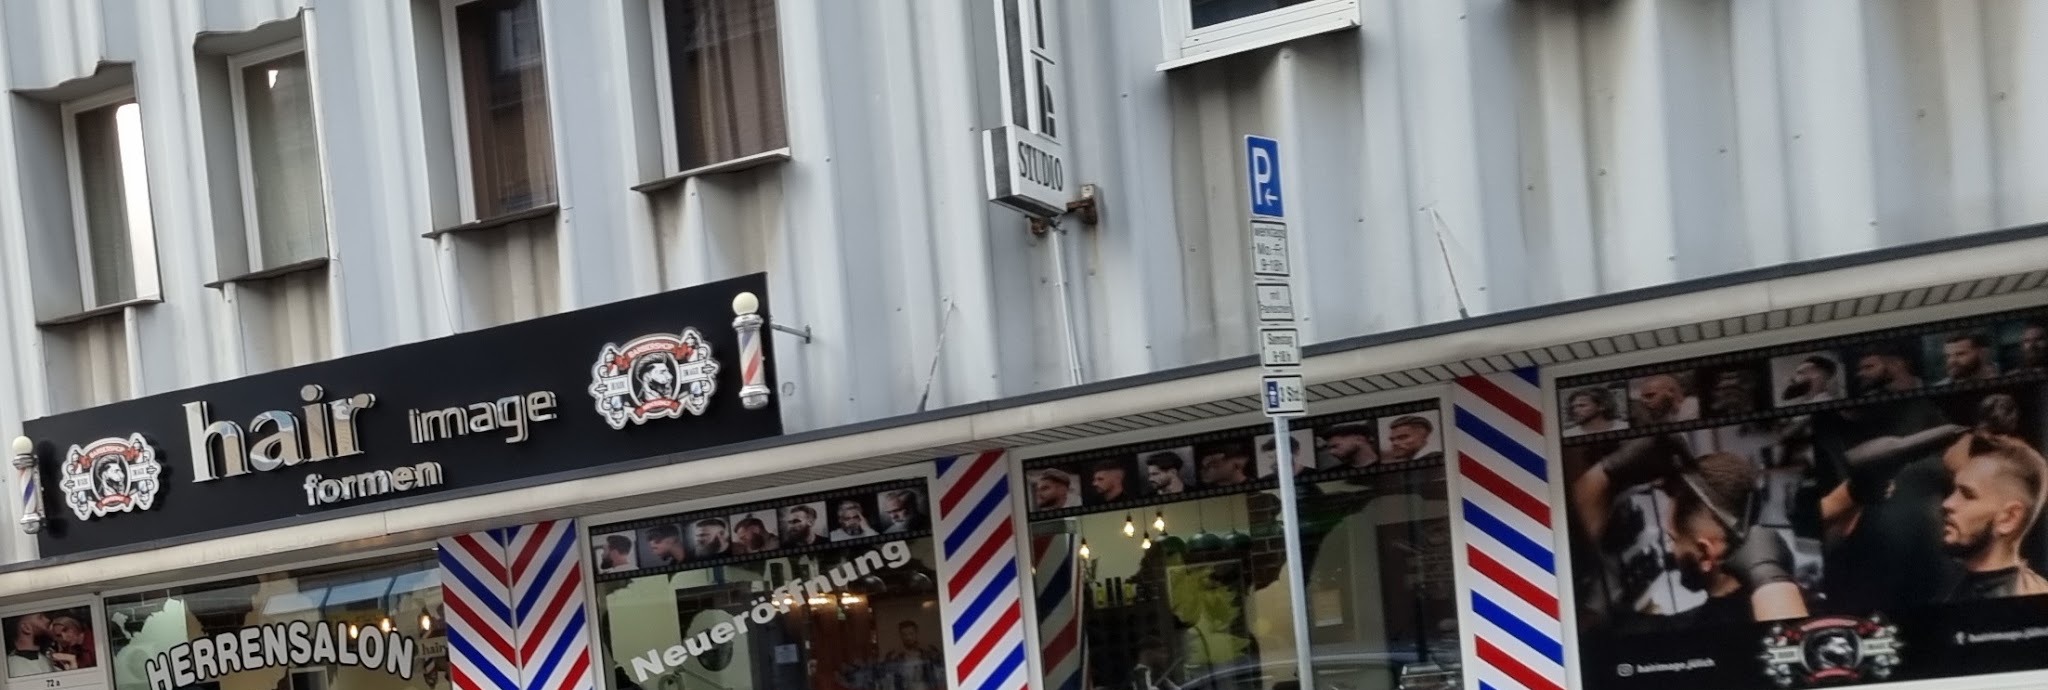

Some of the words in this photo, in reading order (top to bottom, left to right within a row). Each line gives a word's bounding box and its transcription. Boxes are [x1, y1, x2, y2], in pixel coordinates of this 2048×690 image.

[1018, 141, 1063, 191] STUDIO
[1252, 147, 1272, 205] P
[182, 384, 376, 483] hair
[408, 390, 557, 444] image
[303, 461, 442, 506] formen
[630, 539, 912, 683] Neueröffnung
[46, 679, 54, 688] 72
[145, 620, 415, 690] HERRENSALON
